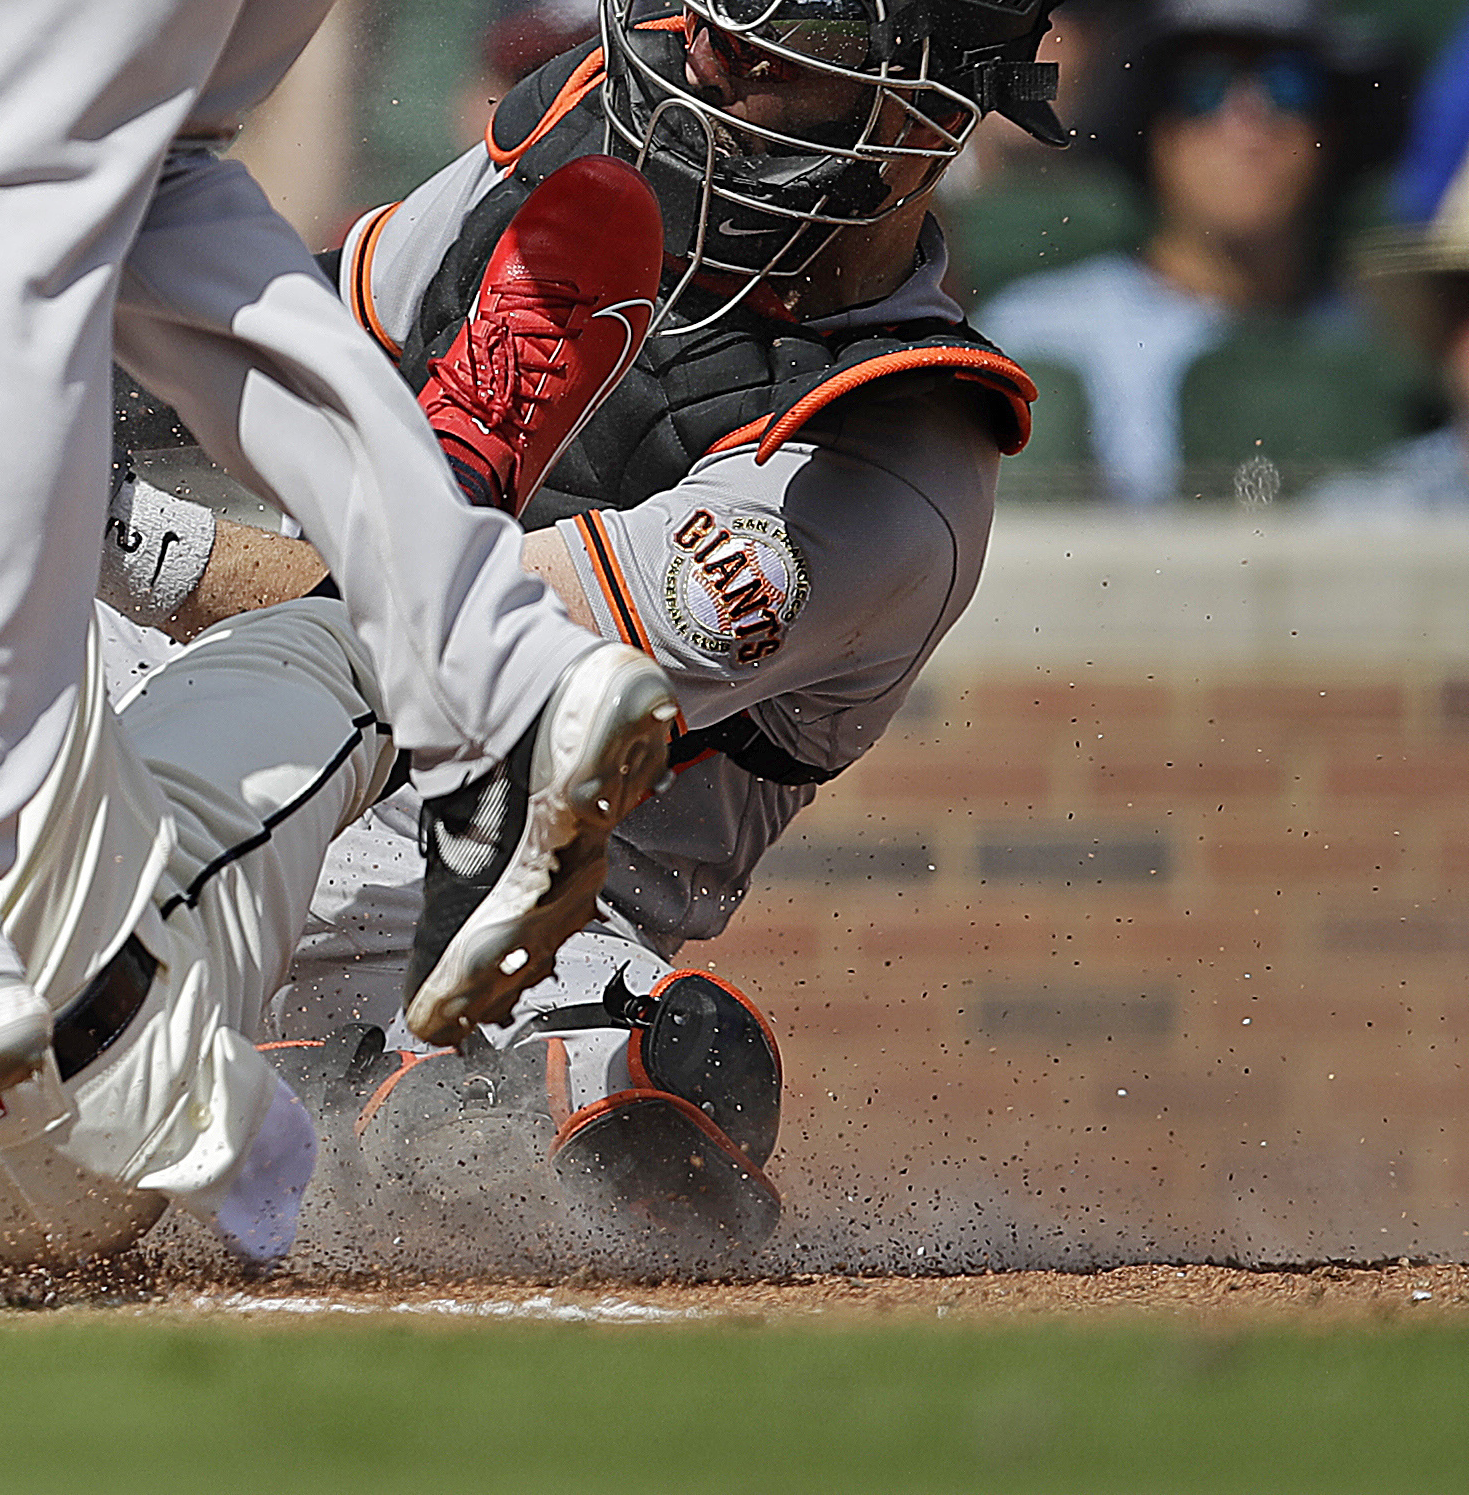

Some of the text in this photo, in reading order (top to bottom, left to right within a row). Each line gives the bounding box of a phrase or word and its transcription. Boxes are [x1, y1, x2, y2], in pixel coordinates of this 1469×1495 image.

[672, 508, 782, 665] GIANTS
[732, 517, 810, 624] SAN FRANCISCO
